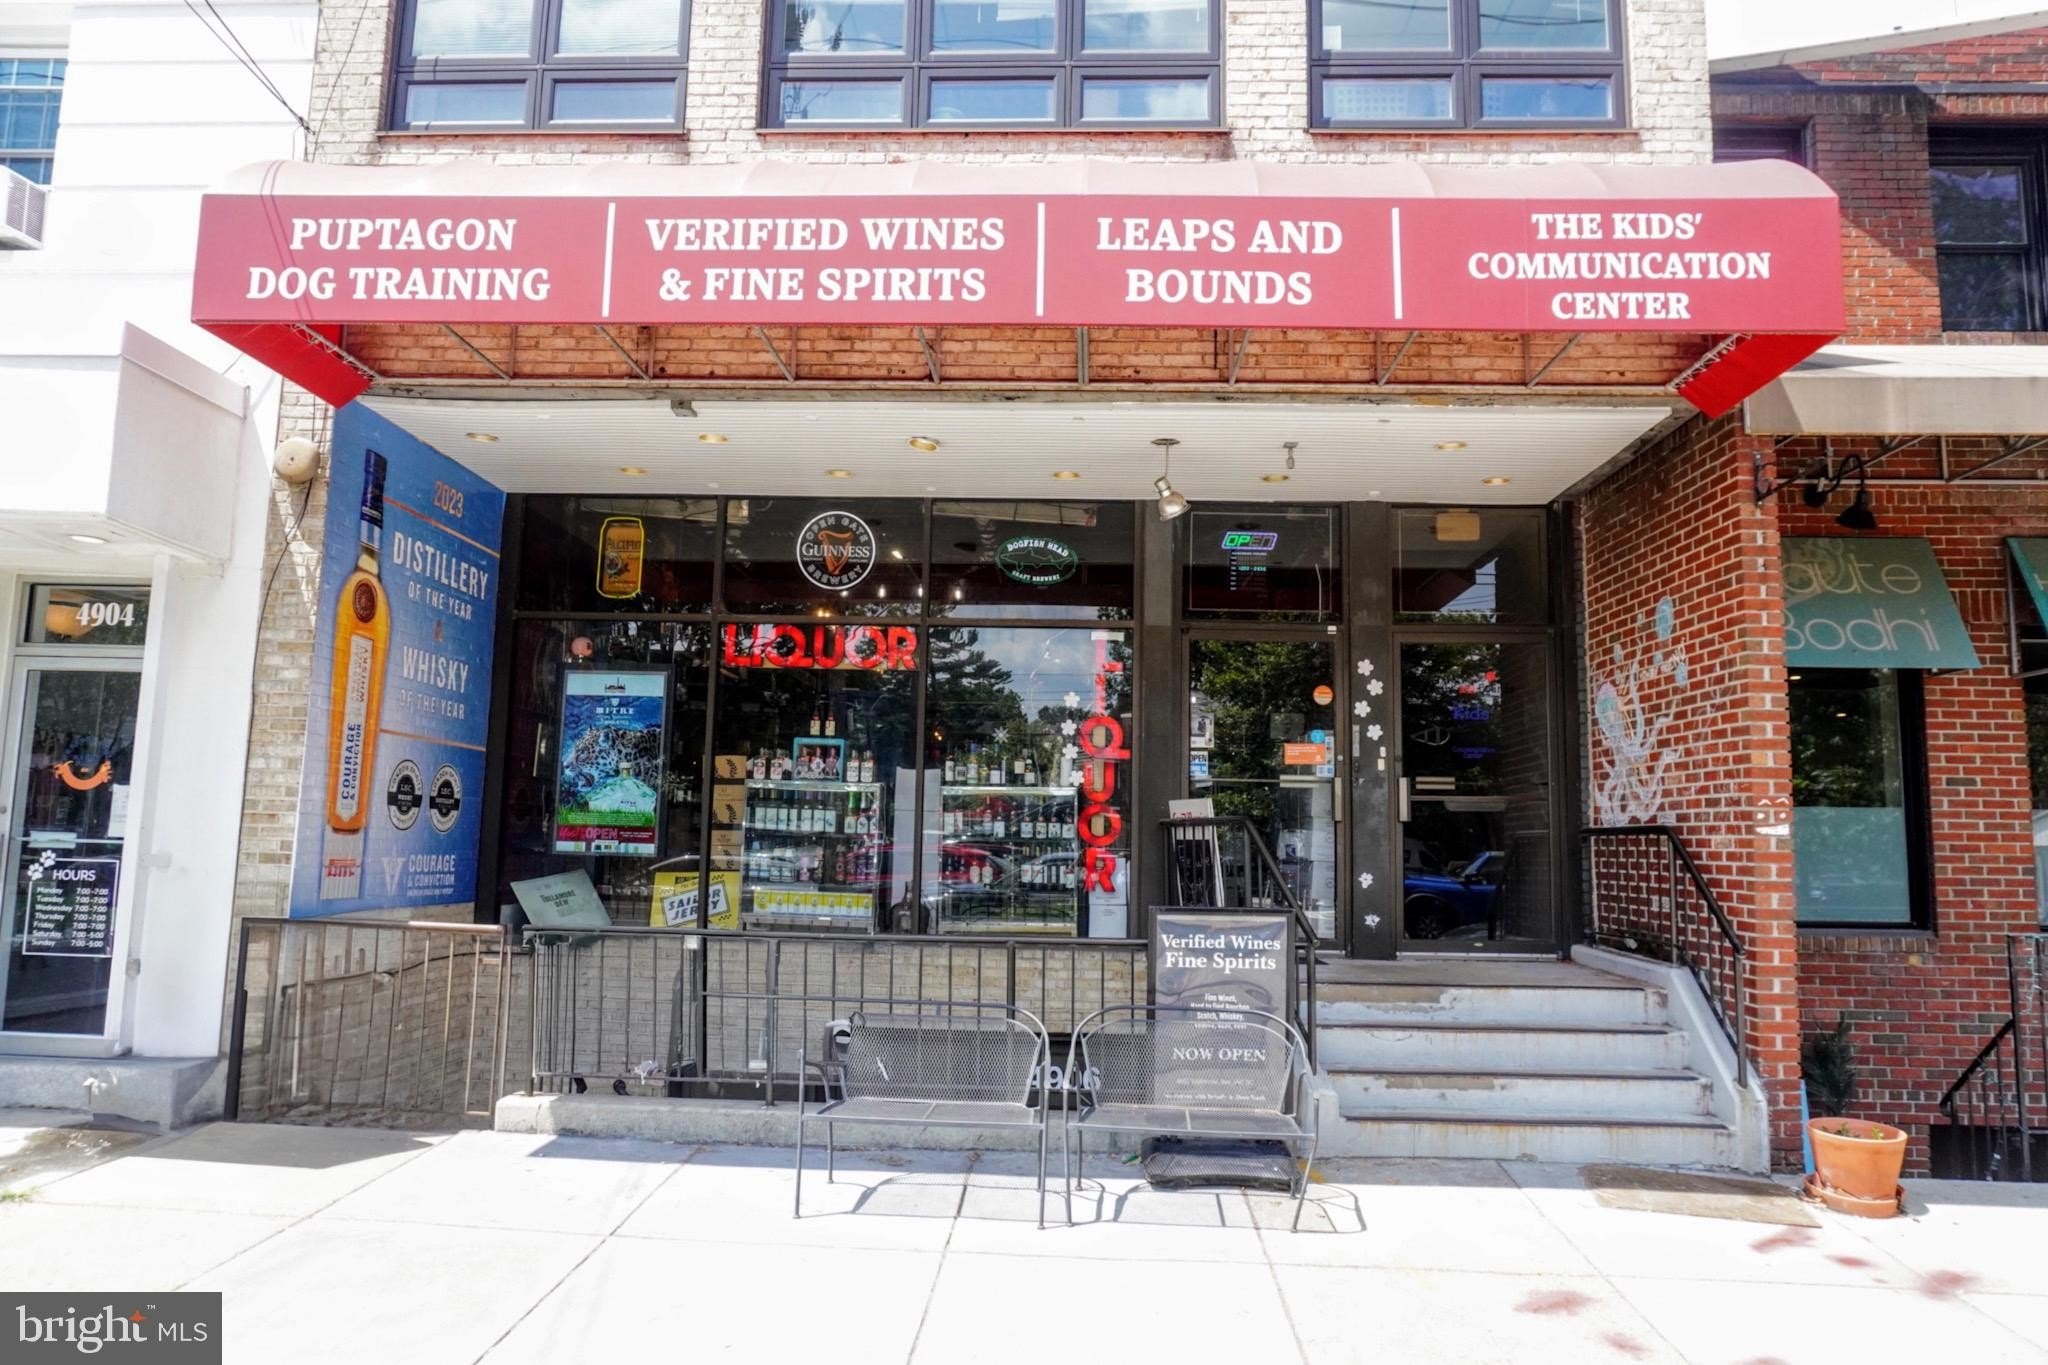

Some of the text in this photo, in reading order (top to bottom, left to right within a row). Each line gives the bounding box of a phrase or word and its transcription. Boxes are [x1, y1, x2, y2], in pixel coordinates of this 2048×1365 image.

[289, 218, 517, 251] PUPTAGON
[645, 217, 1005, 252] VERIFIED WINES
[1096, 217, 1343, 254] LEAPS AND
[1531, 212, 1703, 240] THE KIDS'
[1467, 251, 1771, 280] COMMUNICATION
[247, 267, 552, 302] DOG TRAINING
[659, 268, 986, 302] & FINE SPIRITS
[1125, 268, 1313, 306] BOUNDS
[1551, 292, 1691, 320] CENTER
[434, 480, 464, 520] 2023
[806, 516, 835, 540] OPEN
[801, 542, 870, 558] GUINNESS
[1007, 540, 1069, 557] DOGFISH HEAD
[1226, 535, 1274, 548] OPEN
[393, 531, 489, 601] DISTILLERY
[807, 564, 862, 585] BREWERY
[1782, 553, 1922, 594] aute
[408, 581, 472, 621] OF THE YEAR
[76, 602, 135, 627] 4904
[723, 624, 918, 670] LIQUOR
[403, 645, 469, 695] WHISKY
[399, 688, 465, 721] OF THE YEAR
[342, 723, 356, 800] COURAGE
[351, 724, 361, 789] CONVICTION
[585, 827, 618, 839] OPEN
[53, 869, 96, 881] HOURS
[409, 854, 456, 873] COURAGE
[37, 887, 63, 895] Monday
[415, 874, 454, 887] CONVICTION
[35, 904, 72, 912] Wednesday
[36, 895, 64, 903] Tuesday
[668, 889, 721, 911] SAILR
[672, 900, 720, 921] JERY
[33, 921, 55, 929] Friday
[35, 912, 65, 921] Thursday
[32, 929, 63, 938] Saturday
[32, 939, 56, 947] Sunday
[1161, 934, 1281, 951] Verified Wines
[1165, 952, 1277, 975] Fine Spirits
[1173, 1047, 1266, 1061] NOW OPEN
